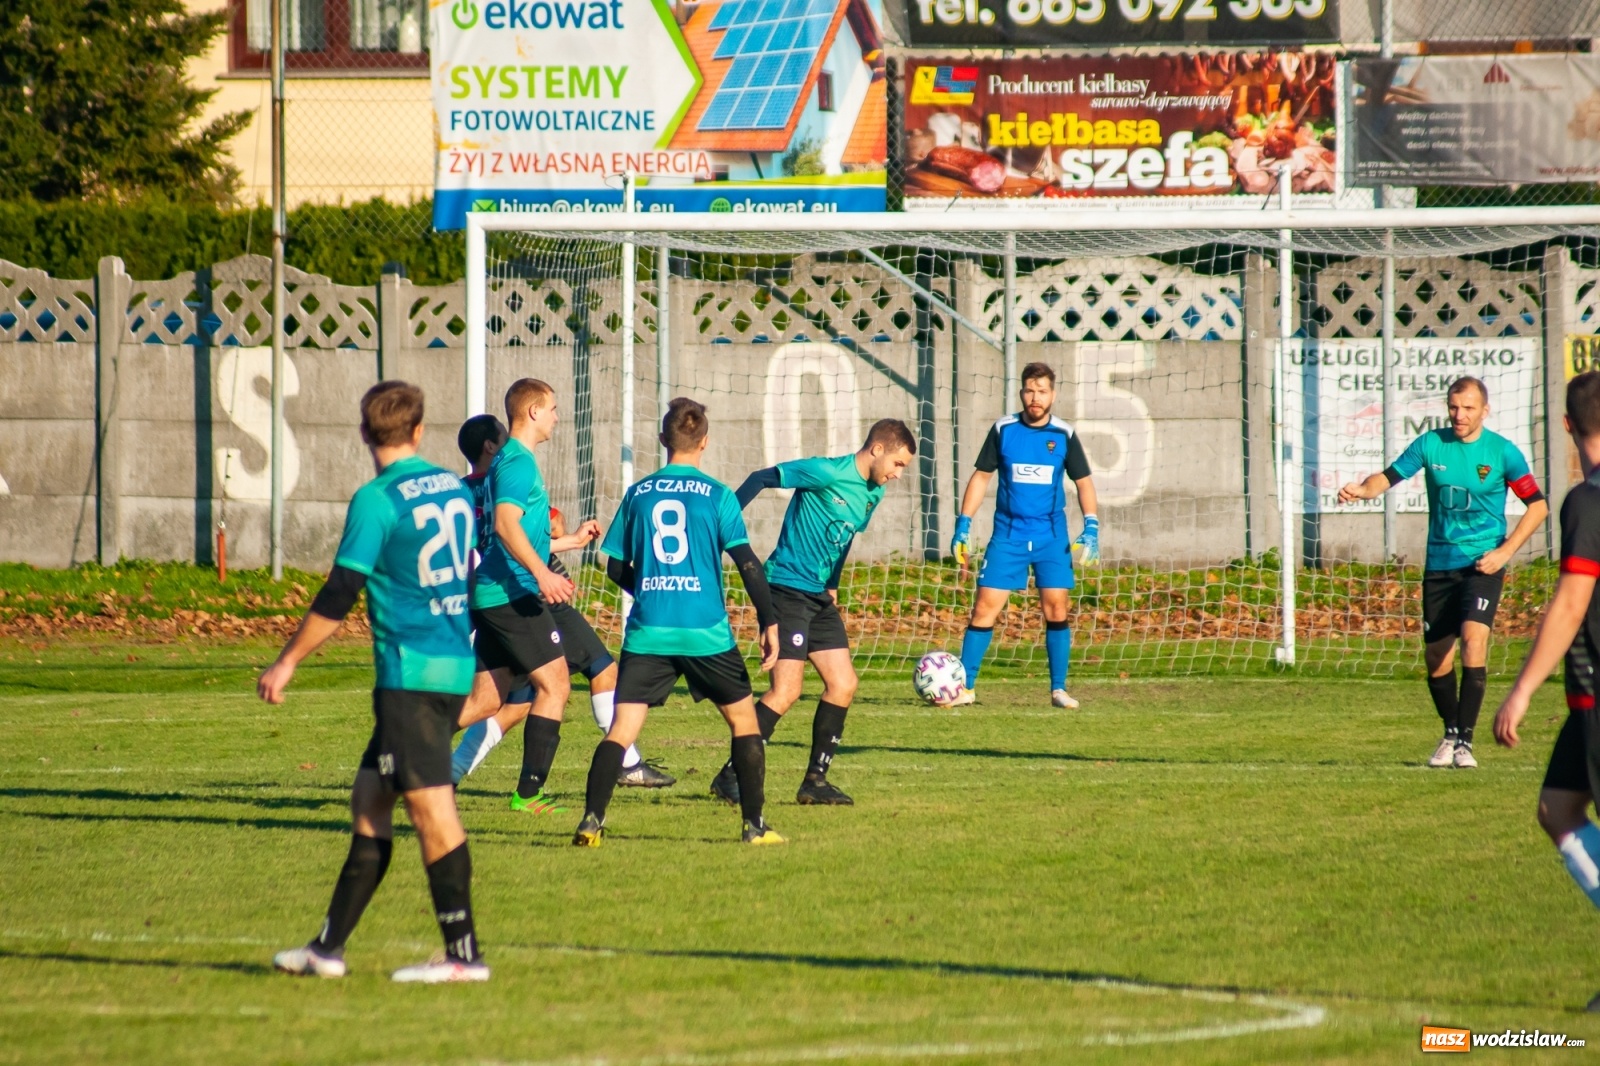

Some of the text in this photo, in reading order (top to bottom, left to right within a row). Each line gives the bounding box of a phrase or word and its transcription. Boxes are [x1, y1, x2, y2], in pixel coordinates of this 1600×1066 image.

[484, 0, 624, 29] ekowat
[450, 65, 629, 99] SYSTEMY
[988, 75, 1075, 95] Producent
[450, 110, 655, 131] FOTOWOLTAICZNE
[988, 112, 1162, 146] kiełbasa
[449, 147, 486, 177] ŻYJ
[491, 153, 504, 173] Z
[612, 152, 713, 180] ENERGIĄ
[1060, 131, 1233, 189] szefa
[1291, 349, 1378, 366] USŁUGI
[634, 479, 712, 496] KS CZARNI
[412, 498, 474, 587] 20
[652, 499, 689, 565] 8
[642, 576, 701, 592] GORZYCE
[1477, 597, 1490, 611] 17
